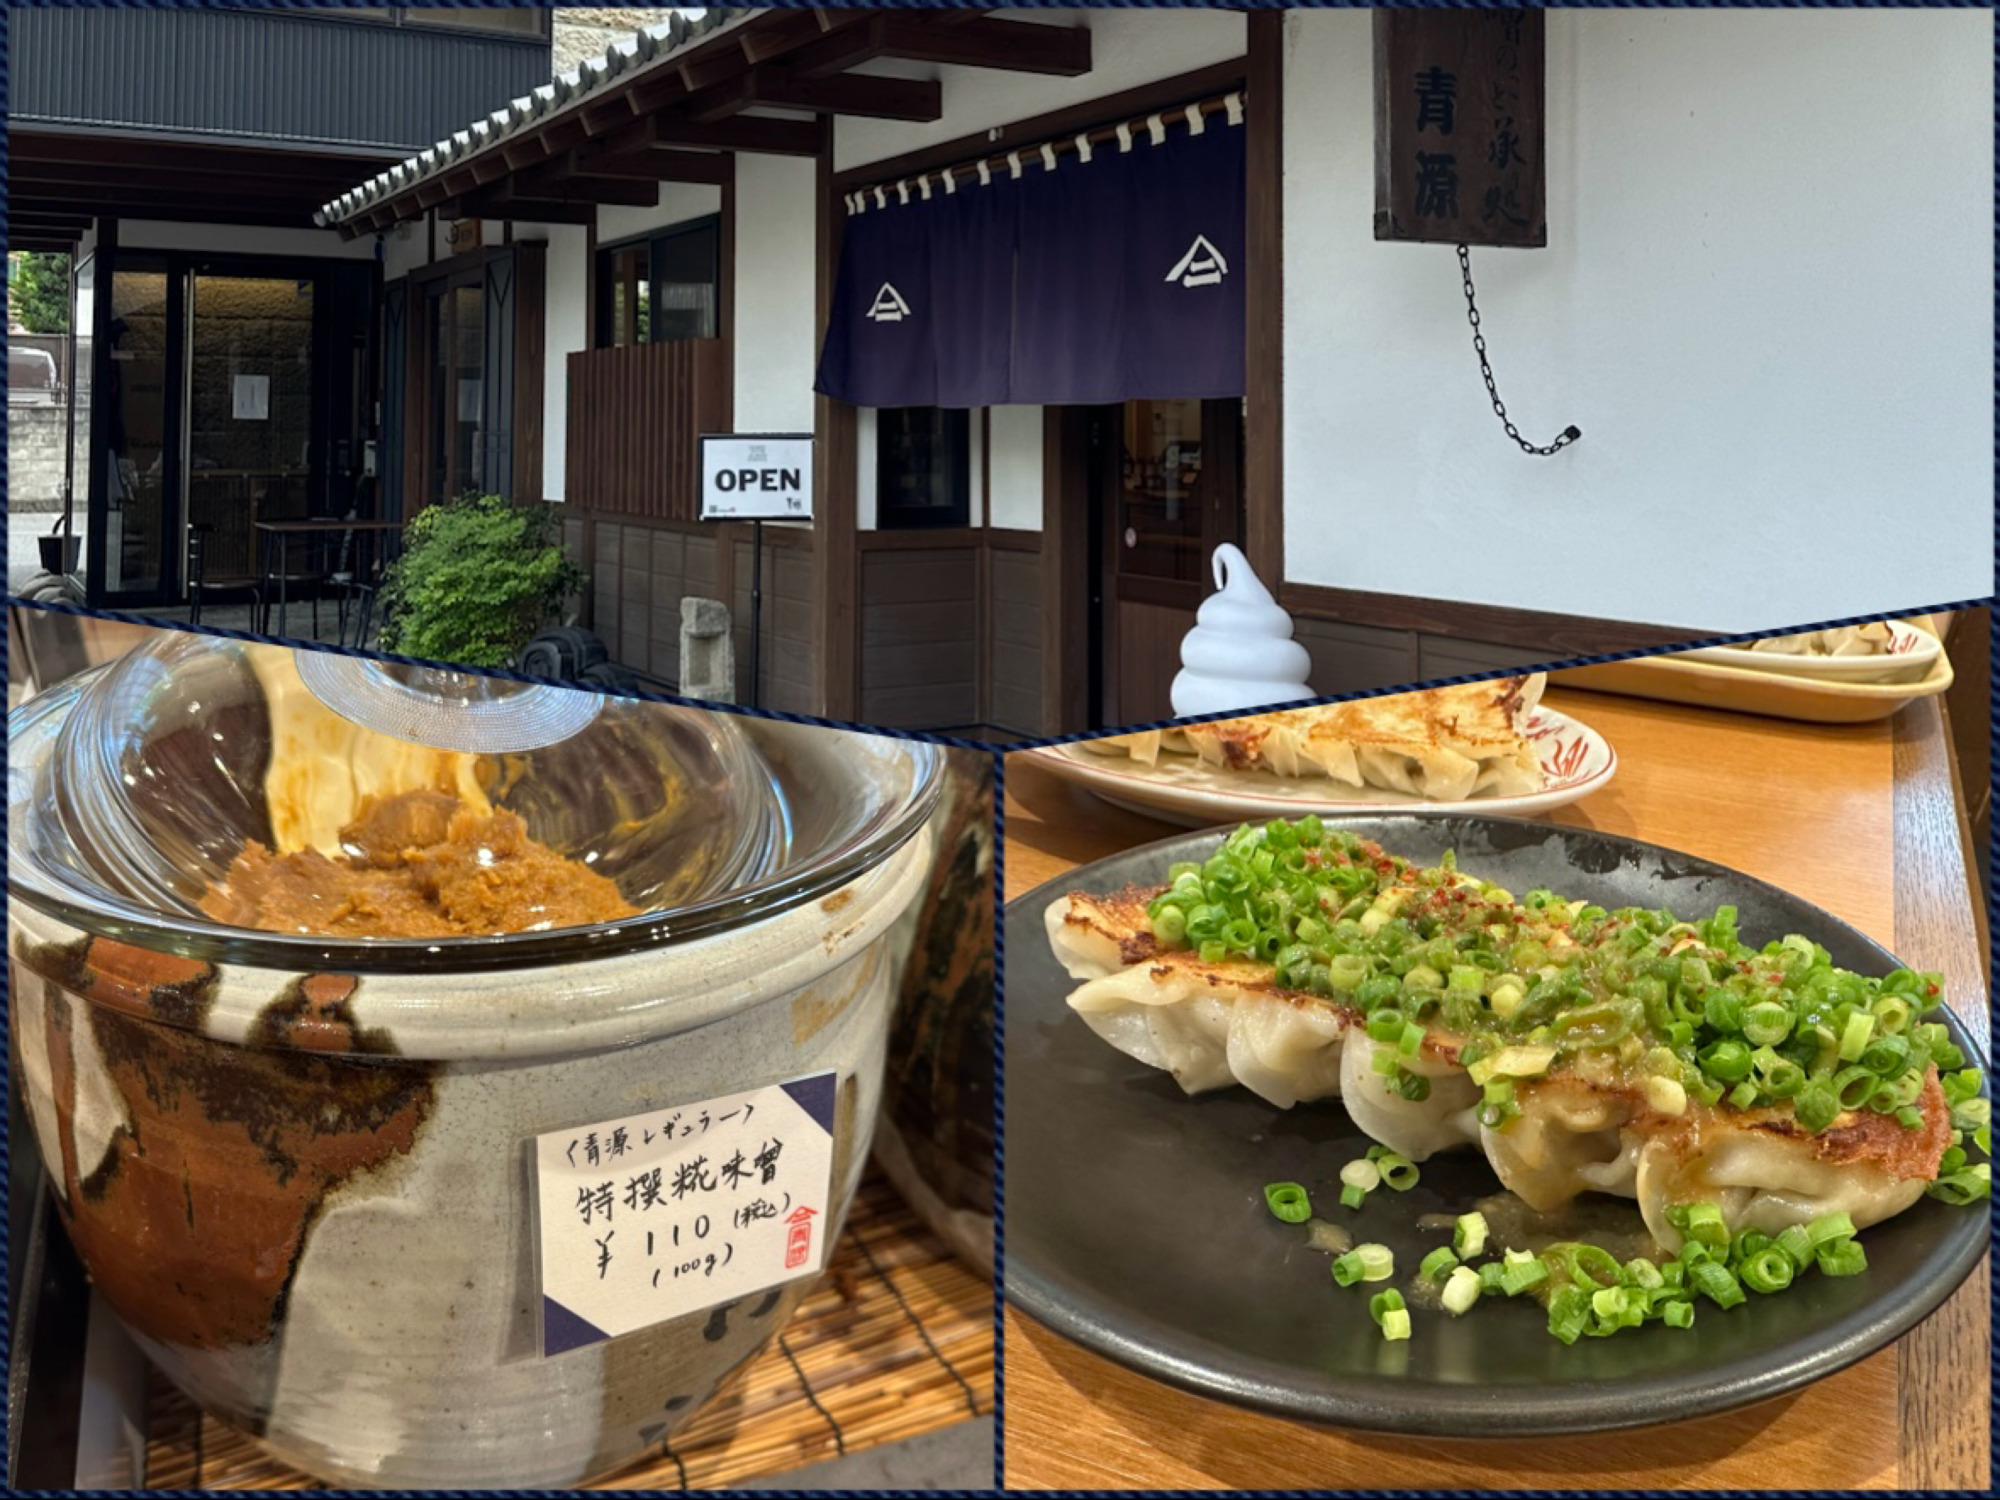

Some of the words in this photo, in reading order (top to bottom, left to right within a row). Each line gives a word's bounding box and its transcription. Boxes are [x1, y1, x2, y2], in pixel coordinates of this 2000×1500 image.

[1413, 66, 1460, 220] 青源
[715, 468, 801, 492] OPEN
[575, 1136, 784, 1225] 特撰糀味噌
